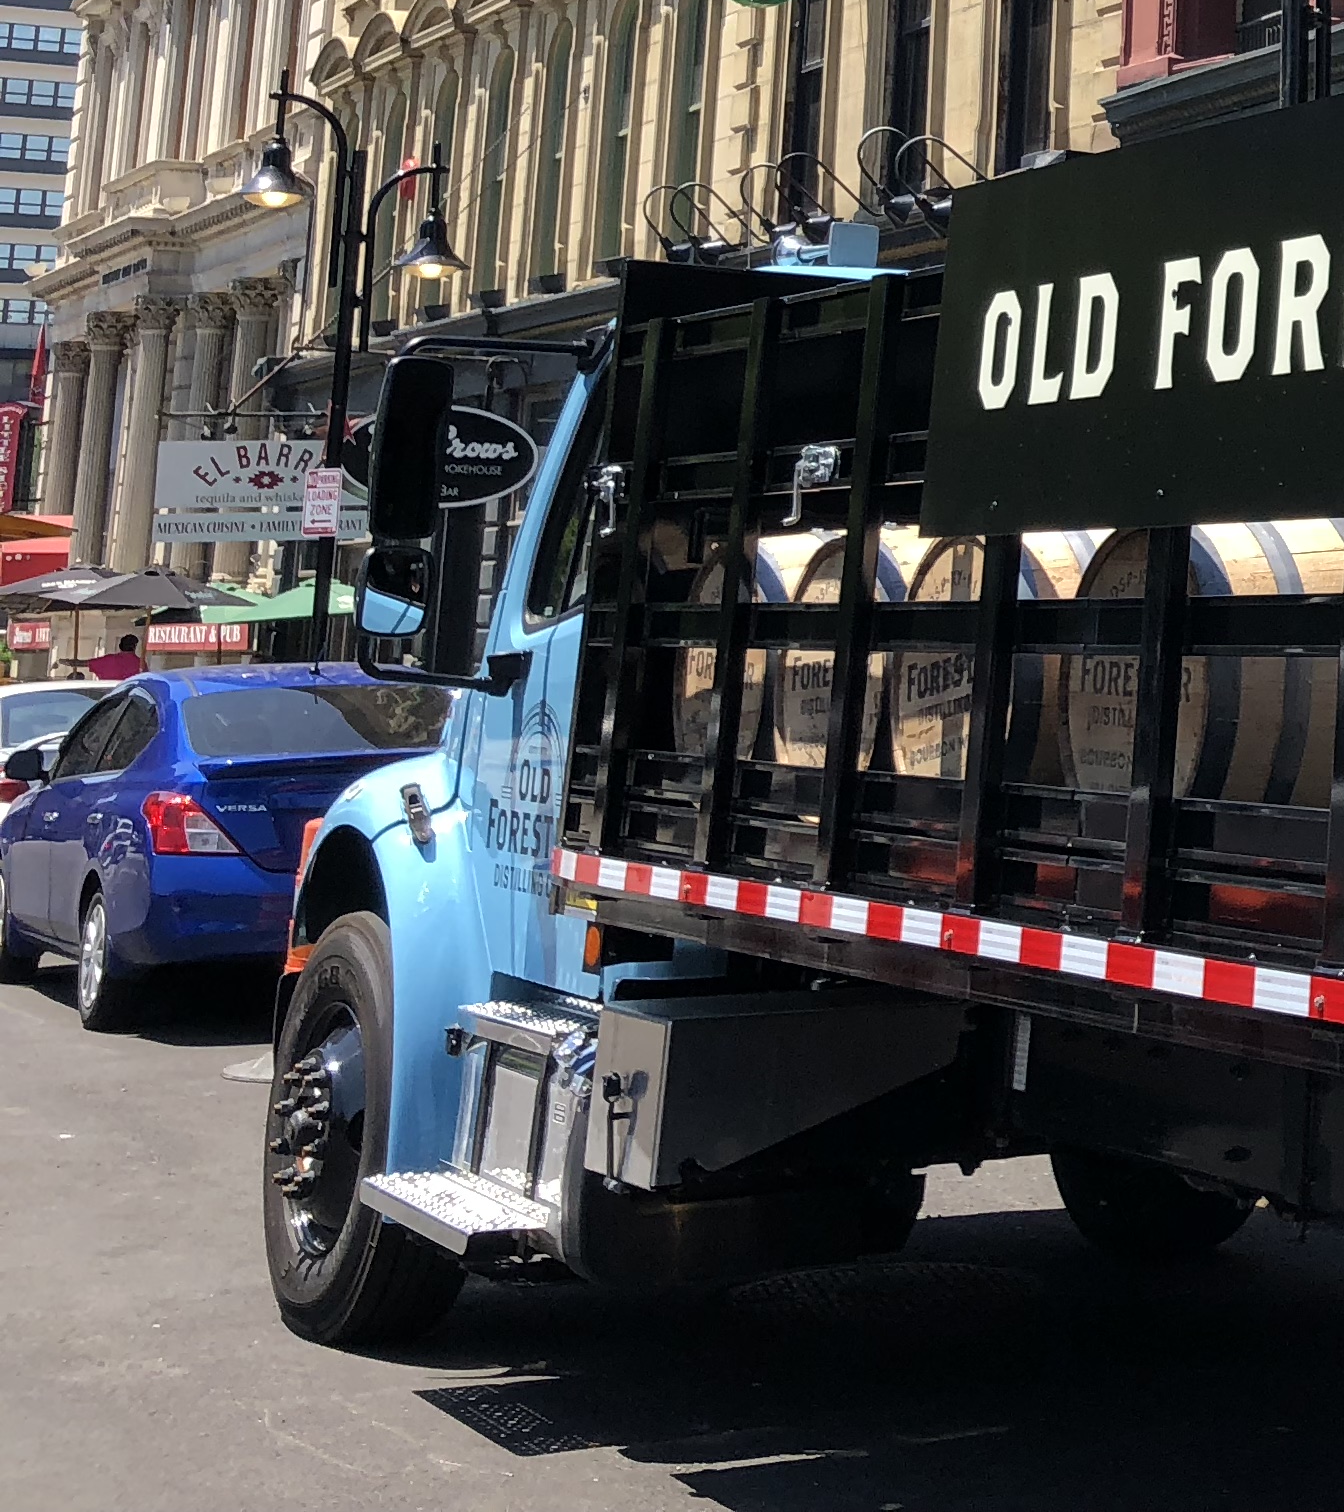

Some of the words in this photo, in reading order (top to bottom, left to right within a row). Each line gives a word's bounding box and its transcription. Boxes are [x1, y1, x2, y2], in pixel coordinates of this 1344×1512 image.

[979, 273, 1120, 410] OLD
[192, 455, 231, 488] EL
[236, 442, 322, 475] BARR
[445, 462, 503, 476] OKEHOUSE
[195, 492, 236, 506] tequila
[239, 492, 261, 503] and
[264, 492, 304, 503] whiske
[308, 489, 338, 502] LOADING
[309, 503, 333, 516] ZONE
[157, 522, 205, 534] MEXICAN
[207, 521, 246, 533] CUISINE
[259, 520, 297, 533] FAMILY
[148, 623, 207, 644] RESTAURANT
[208, 625, 217, 643] &
[220, 623, 241, 643] PUB
[519, 759, 550, 804] OLD
[215, 804, 268, 813] VERSA
[486, 798, 554, 859] FOREST
